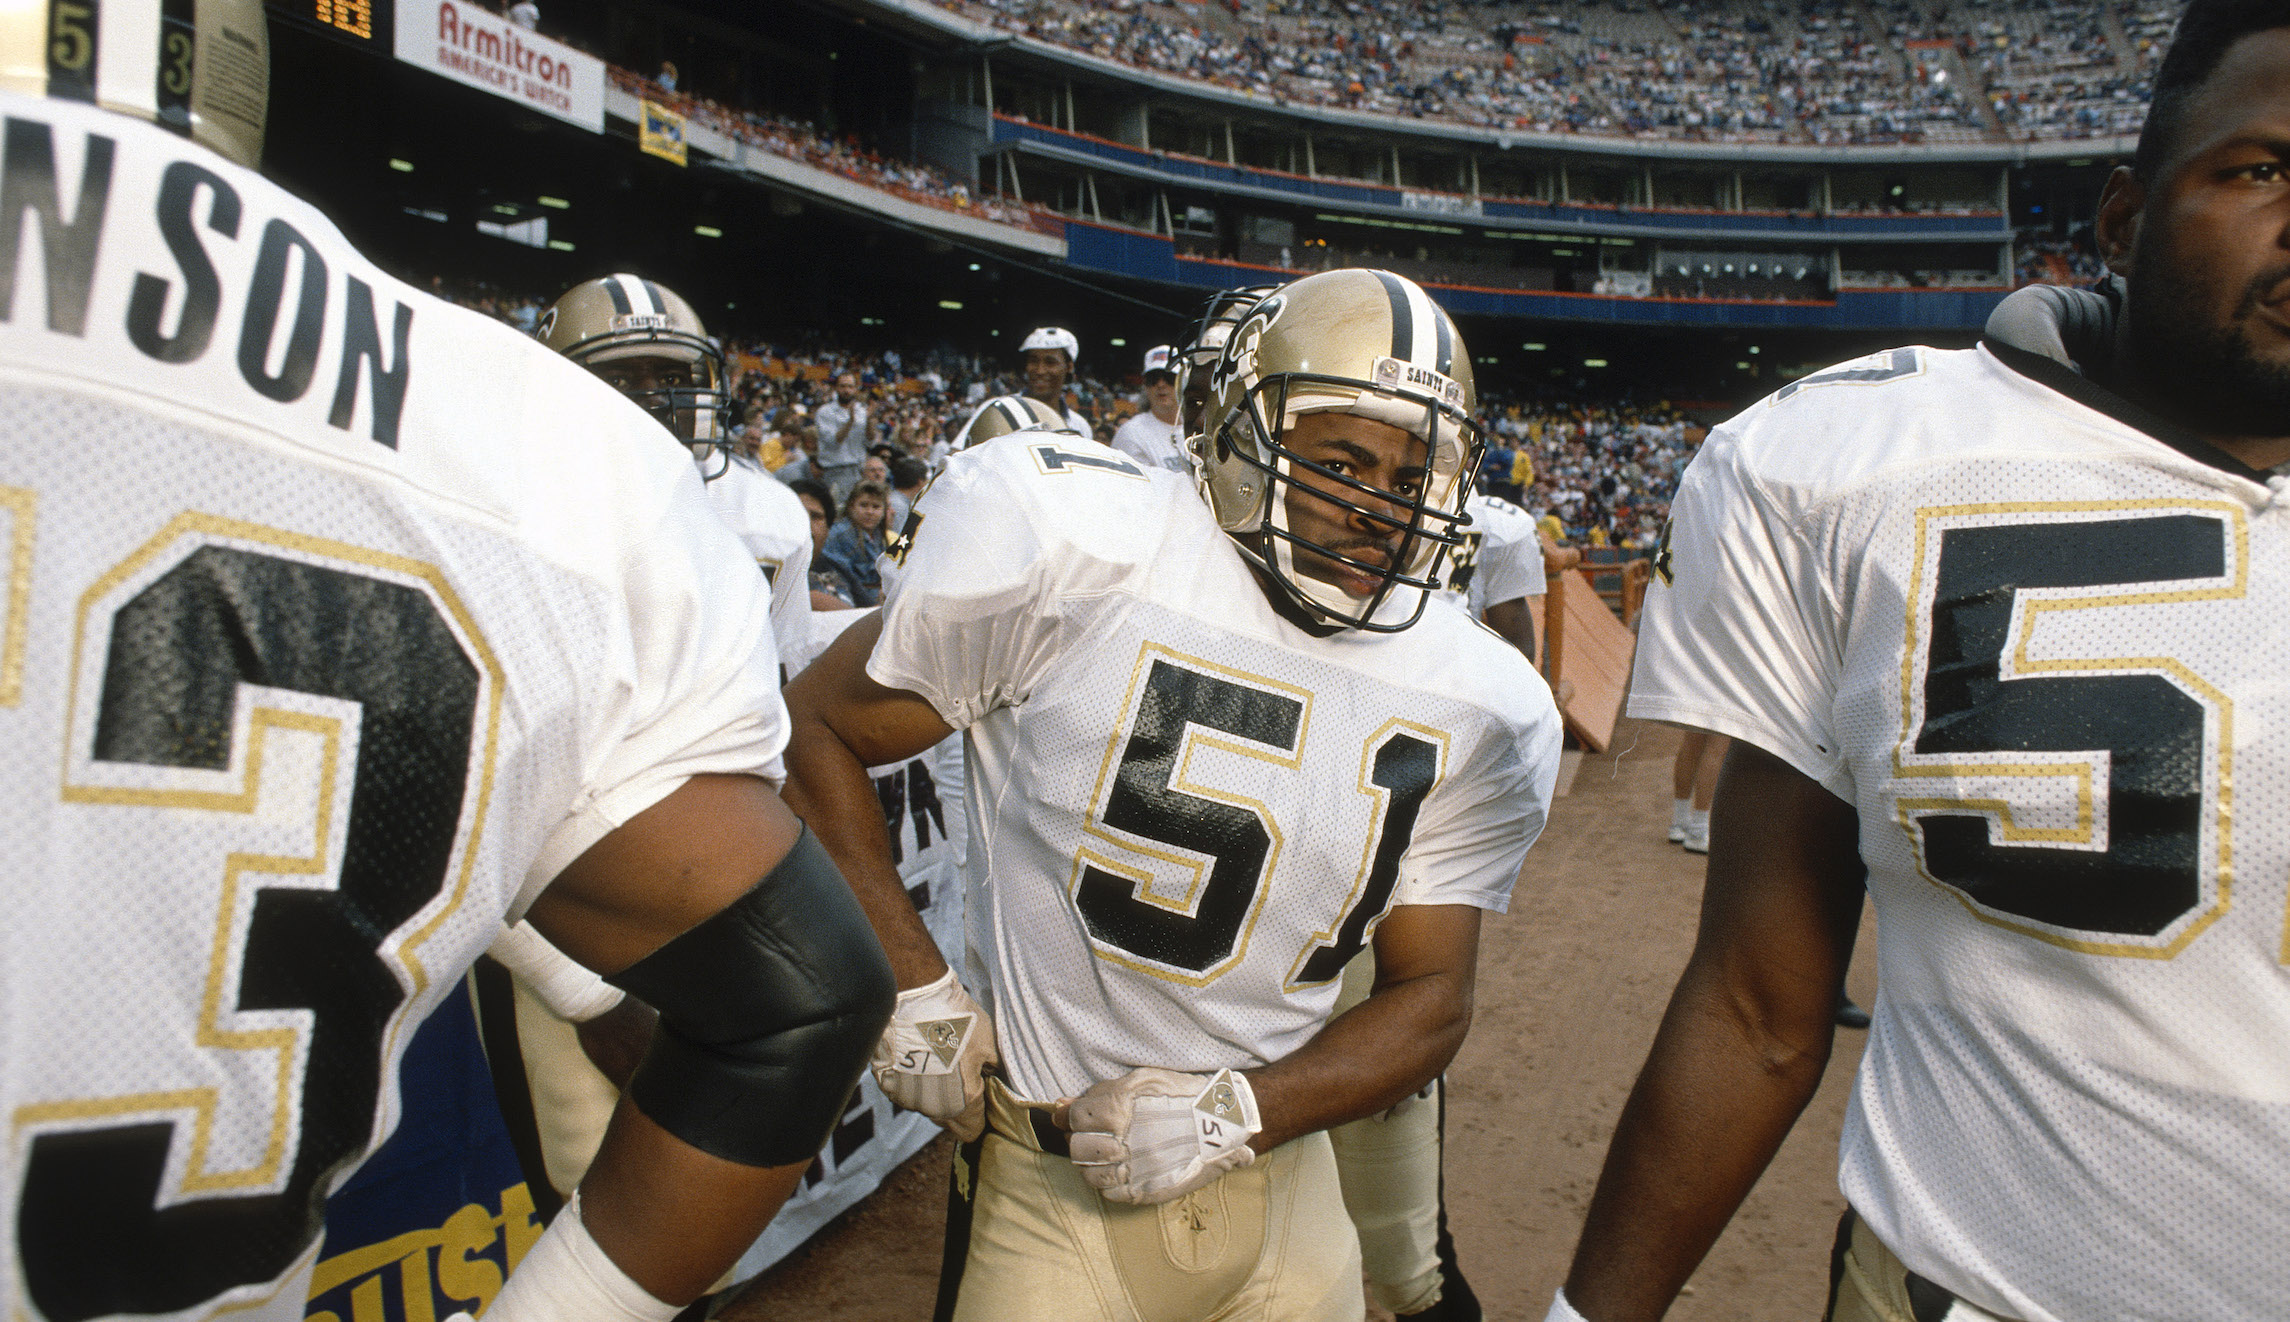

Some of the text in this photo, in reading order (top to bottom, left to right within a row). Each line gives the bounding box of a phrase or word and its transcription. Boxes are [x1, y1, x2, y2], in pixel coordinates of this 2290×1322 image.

[53, 3, 92, 70] 5
[163, 32, 191, 95] 3
[439, 2, 571, 90] Armitron
[0, 116, 414, 451] NSON
[1406, 367, 1443, 393] SAINTS
[1027, 443, 1150, 482] 1
[1067, 641, 1451, 994] 51
[899, 1050, 930, 1074] 51
[1201, 1118, 1223, 1148] 51
